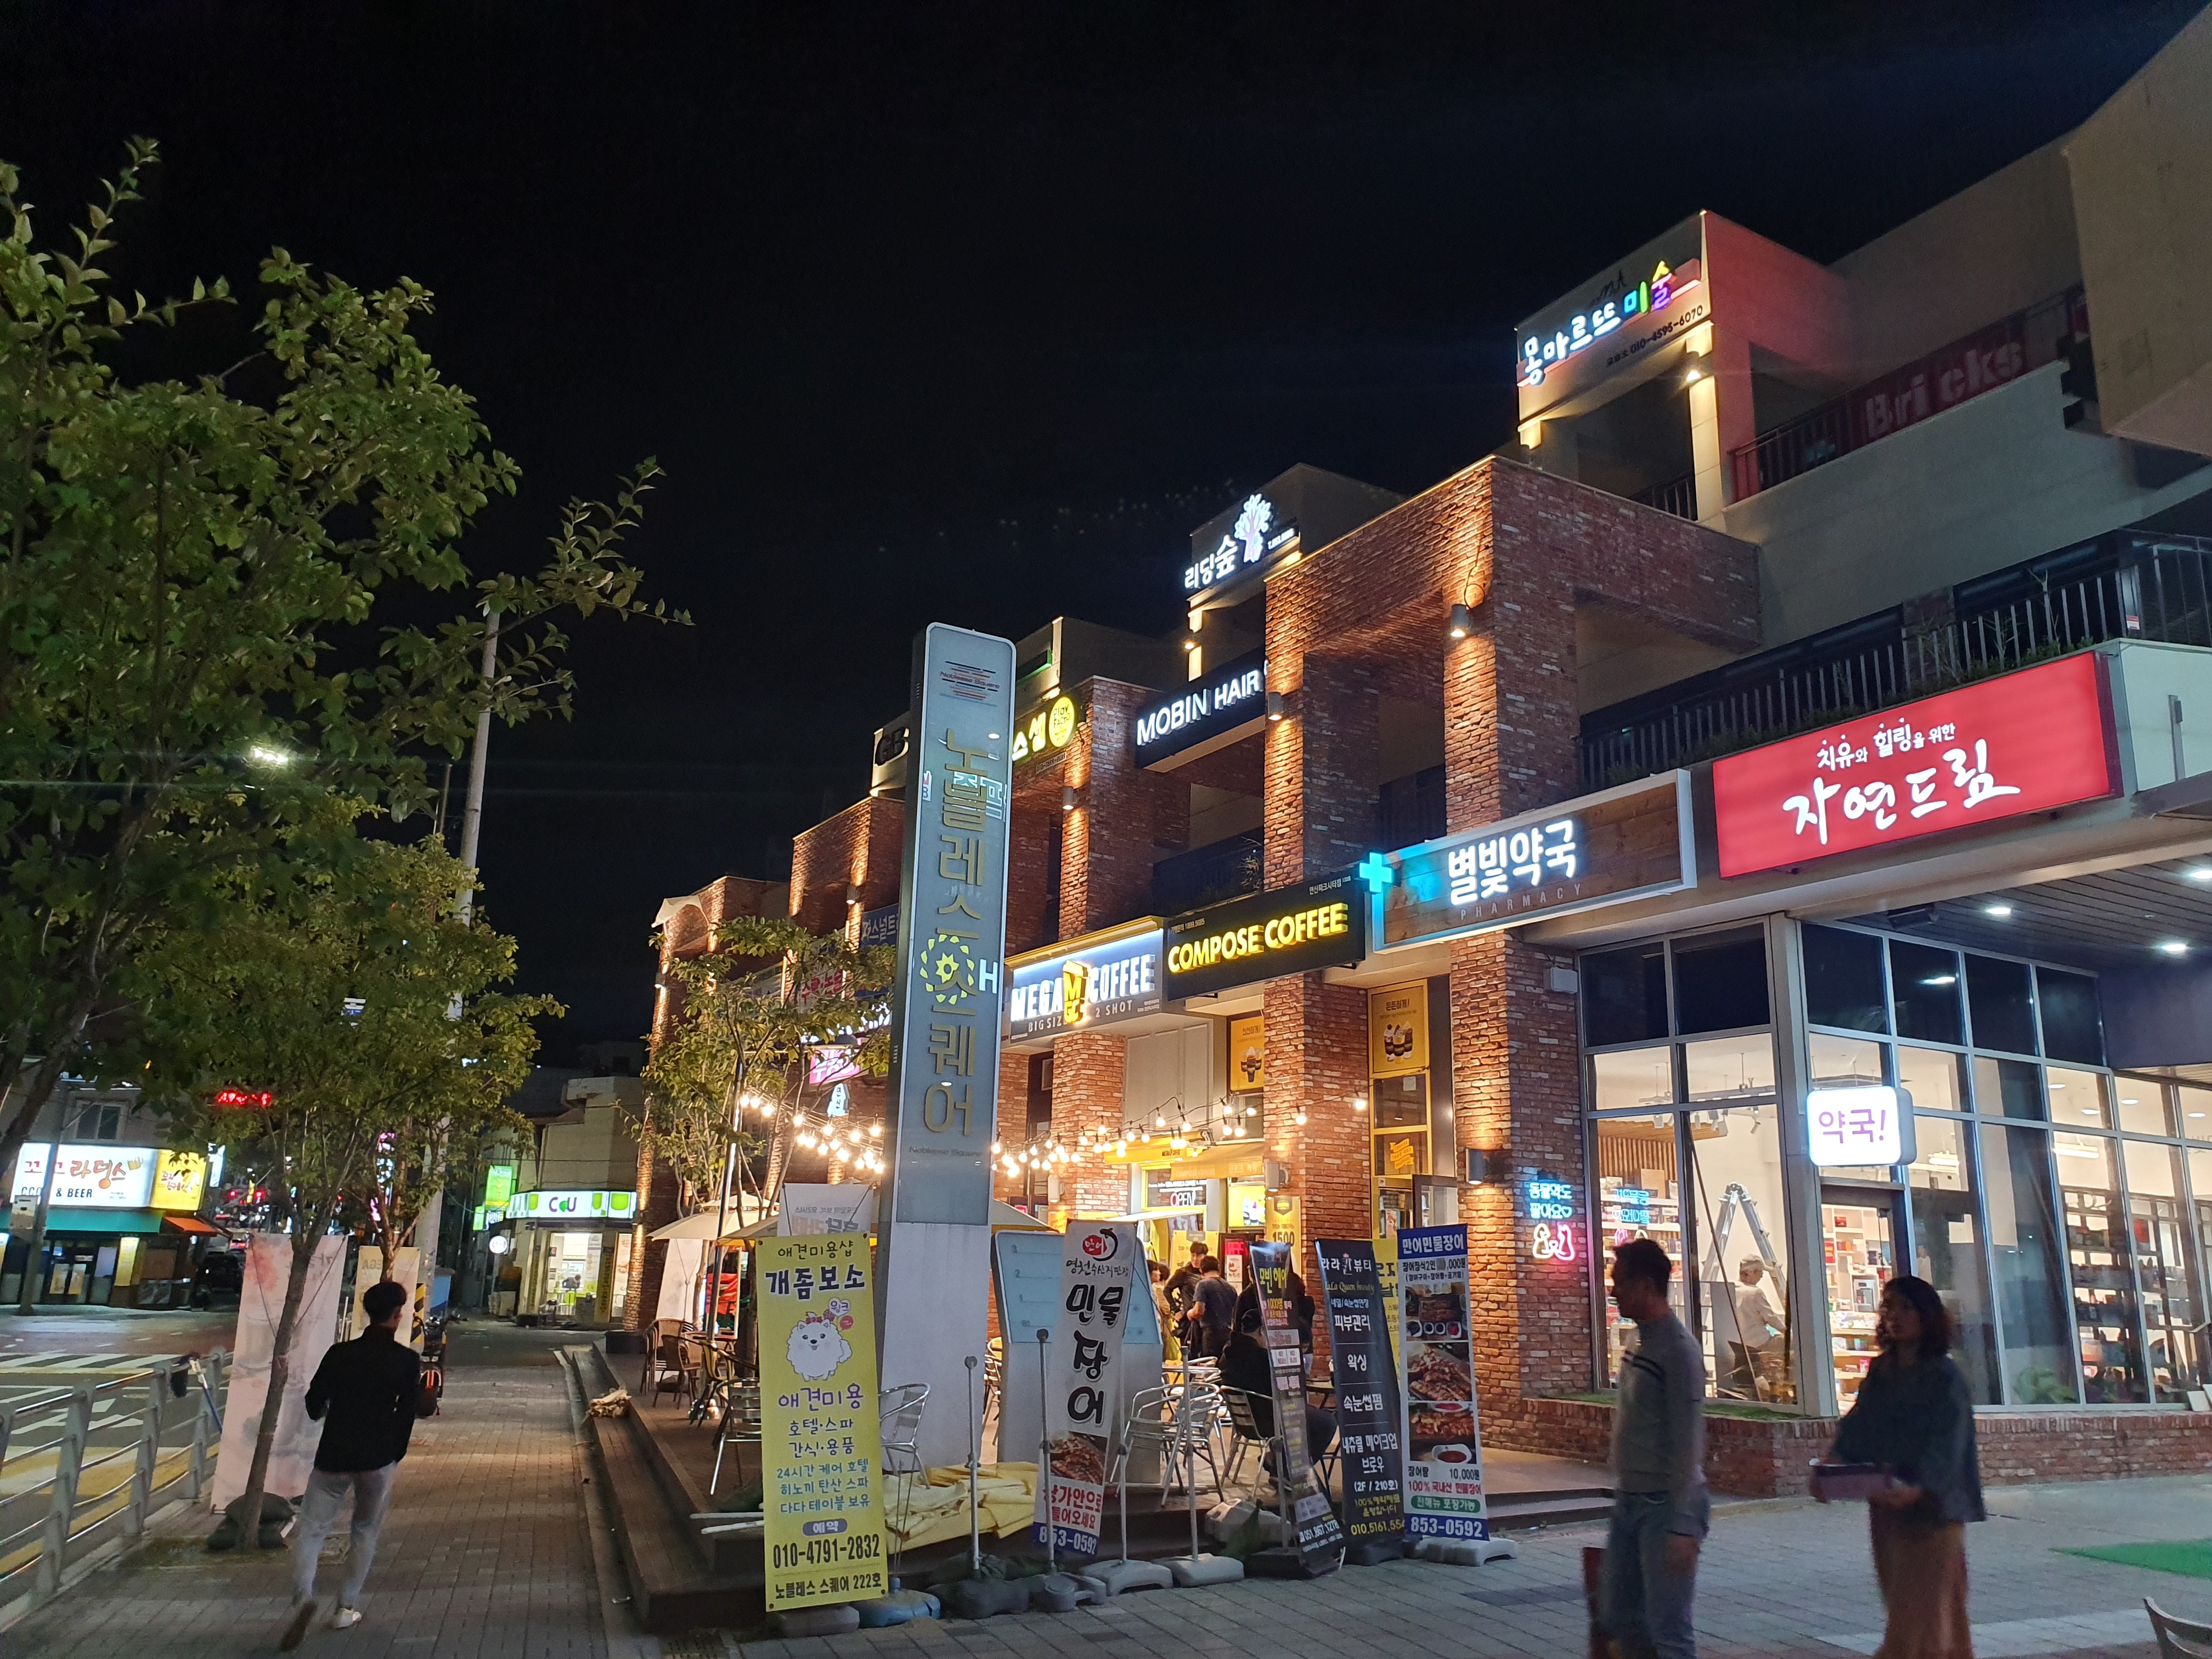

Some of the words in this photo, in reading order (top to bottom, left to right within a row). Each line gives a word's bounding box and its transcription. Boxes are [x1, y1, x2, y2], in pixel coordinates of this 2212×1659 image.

[1523, 302, 1621, 386] 몽마르뜨
[1623, 259, 1672, 313] 미술
[1865, 340, 2024, 439] Bricks
[1184, 534, 1239, 589] 리딩숲
[974, 678, 1000, 689] Square
[1136, 688, 1210, 747] MOBIN
[1214, 669, 1261, 710] HAIR
[1816, 732, 1869, 771] 치유와
[1873, 716, 1925, 759] 힐링을
[1928, 722, 1956, 745] 위한
[1782, 738, 2022, 845] 자연드림
[1448, 820, 1577, 906] 별빛약국
[1460, 883, 1582, 921] PHARMACY
[862, 913, 899, 941] 퍼스널트
[1167, 925, 1263, 974] COMPOSE
[1264, 902, 1348, 949] COFFEE
[1010, 977, 1064, 1022] MEGA
[1088, 954, 1155, 1003] COFFEE
[1028, 1019, 1044, 1032] BIG
[1095, 1007, 1101, 1018] 2
[1105, 999, 1133, 1016] SHOT
[1818, 1108, 1886, 1144] 약국!
[67, 1188, 93, 1199] BEER
[1170, 1191, 1197, 1207] OPEN
[1529, 1182, 1573, 1200] 동물약도
[549, 1196, 578, 1212] CU
[1529, 1202, 1563, 1219] 팔아요
[777, 1239, 854, 1260] 애견미용샵
[1272, 1231, 1295, 1247] 1500
[1402, 1233, 1464, 1255] 만어민물장어
[765, 1263, 866, 1300] 개좀보소
[830, 1300, 850, 1313] 윙크
[1334, 1314, 1372, 1331] 피부관리
[1347, 1353, 1368, 1372] 왁싱
[777, 1383, 864, 1412] 애견미용
[1343, 1393, 1384, 1413] 속눈썹펌
[788, 1417, 855, 1437] 호텔·스파
[788, 1436, 855, 1459] 간식·용품
[1365, 1432, 1398, 1452] 메이크업
[776, 1464, 815, 1479] 24시간
[819, 1462, 843, 1475] 케어
[847, 1458, 869, 1474] 호텔
[1361, 1456, 1385, 1475] 브로우
[1408, 1465, 1430, 1478] 장어탕
[1449, 1468, 1480, 1481] 10,000원
[780, 1481, 815, 1496] 히노끼
[818, 1479, 842, 1493] 탄산
[845, 1476, 870, 1490] 스파
[1408, 1480, 1431, 1492] 100%
[1432, 1481, 1453, 1494] 국내산
[780, 1500, 806, 1515] 다다
[808, 1494, 845, 1512] 테이블
[848, 1493, 871, 1508] 보유
[812, 1520, 839, 1534] 예약
[1051, 1503, 1097, 1530] 들어오세요
[1350, 1519, 1406, 1536] 010.5161.55
[1410, 1516, 1483, 1538] 853-0592
[772, 1533, 881, 1569] 010-4791-2832
[775, 1579, 816, 1600] 노블레스
[819, 1576, 850, 1594] 스퀘어
[853, 1572, 882, 1589] 222호
